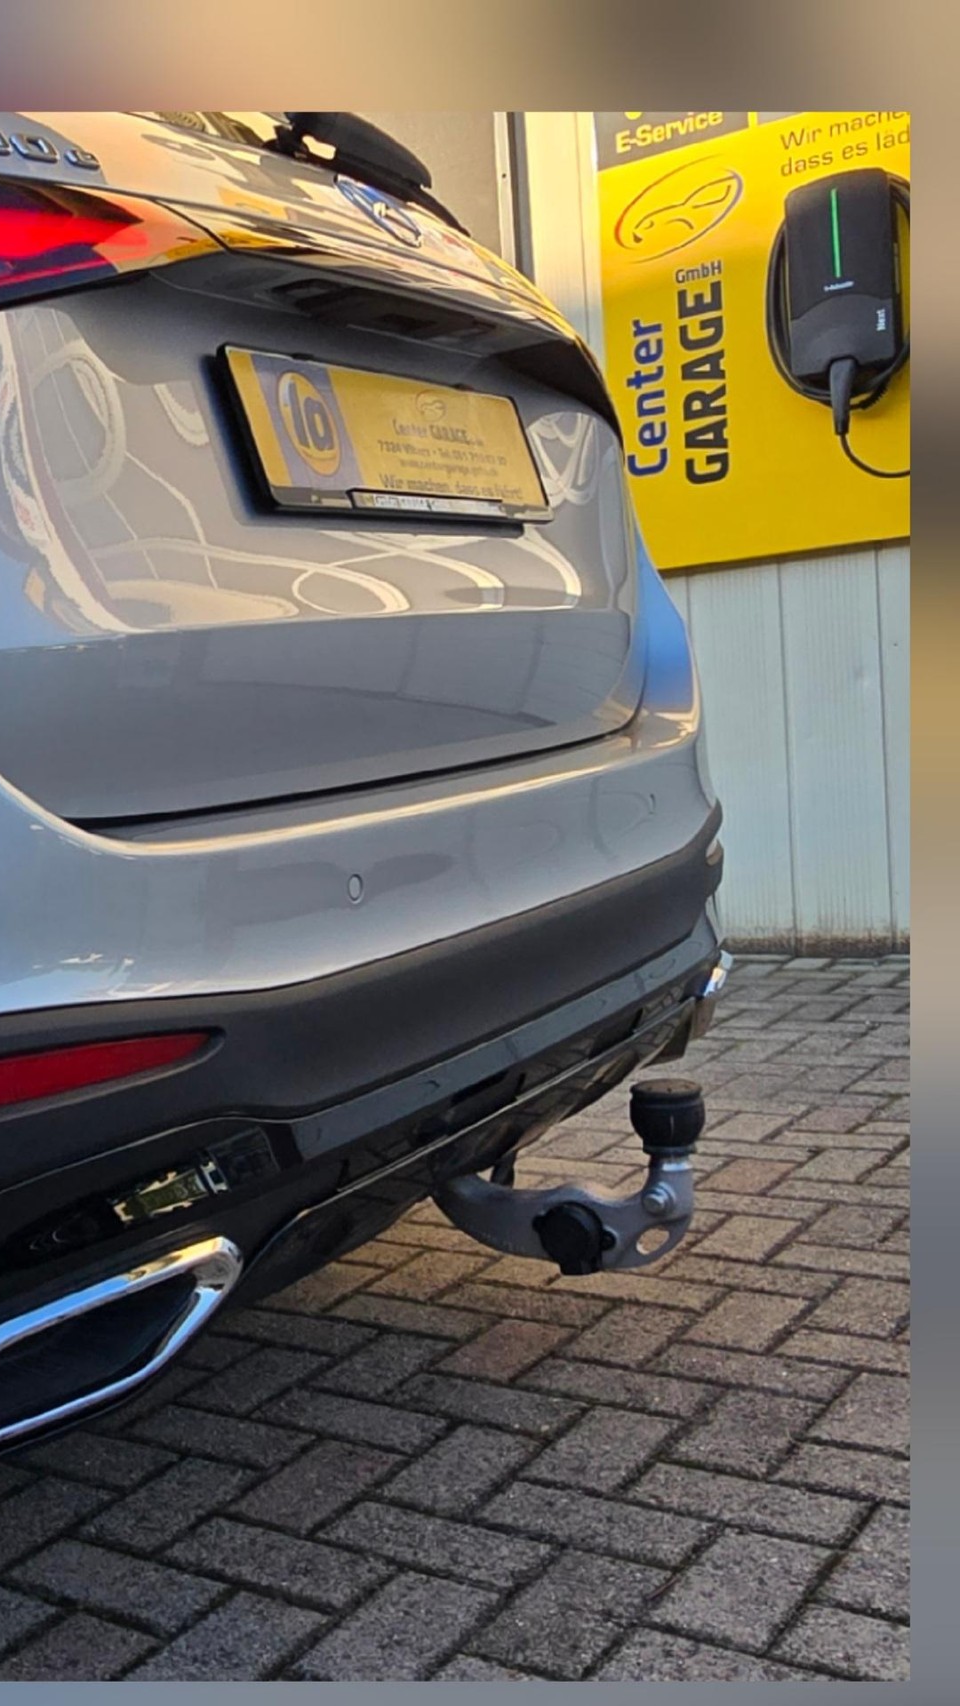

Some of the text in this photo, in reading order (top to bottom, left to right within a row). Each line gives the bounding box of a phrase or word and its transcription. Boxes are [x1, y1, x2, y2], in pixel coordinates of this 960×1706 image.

[615, 112, 723, 154] E-Service
[779, 112, 910, 150] Wir mache
[779, 150, 834, 177] dass
[842, 140, 869, 160] es
[675, 260, 722, 284] GmbH
[626, 319, 668, 477] Center
[677, 280, 730, 485] GARAGE
